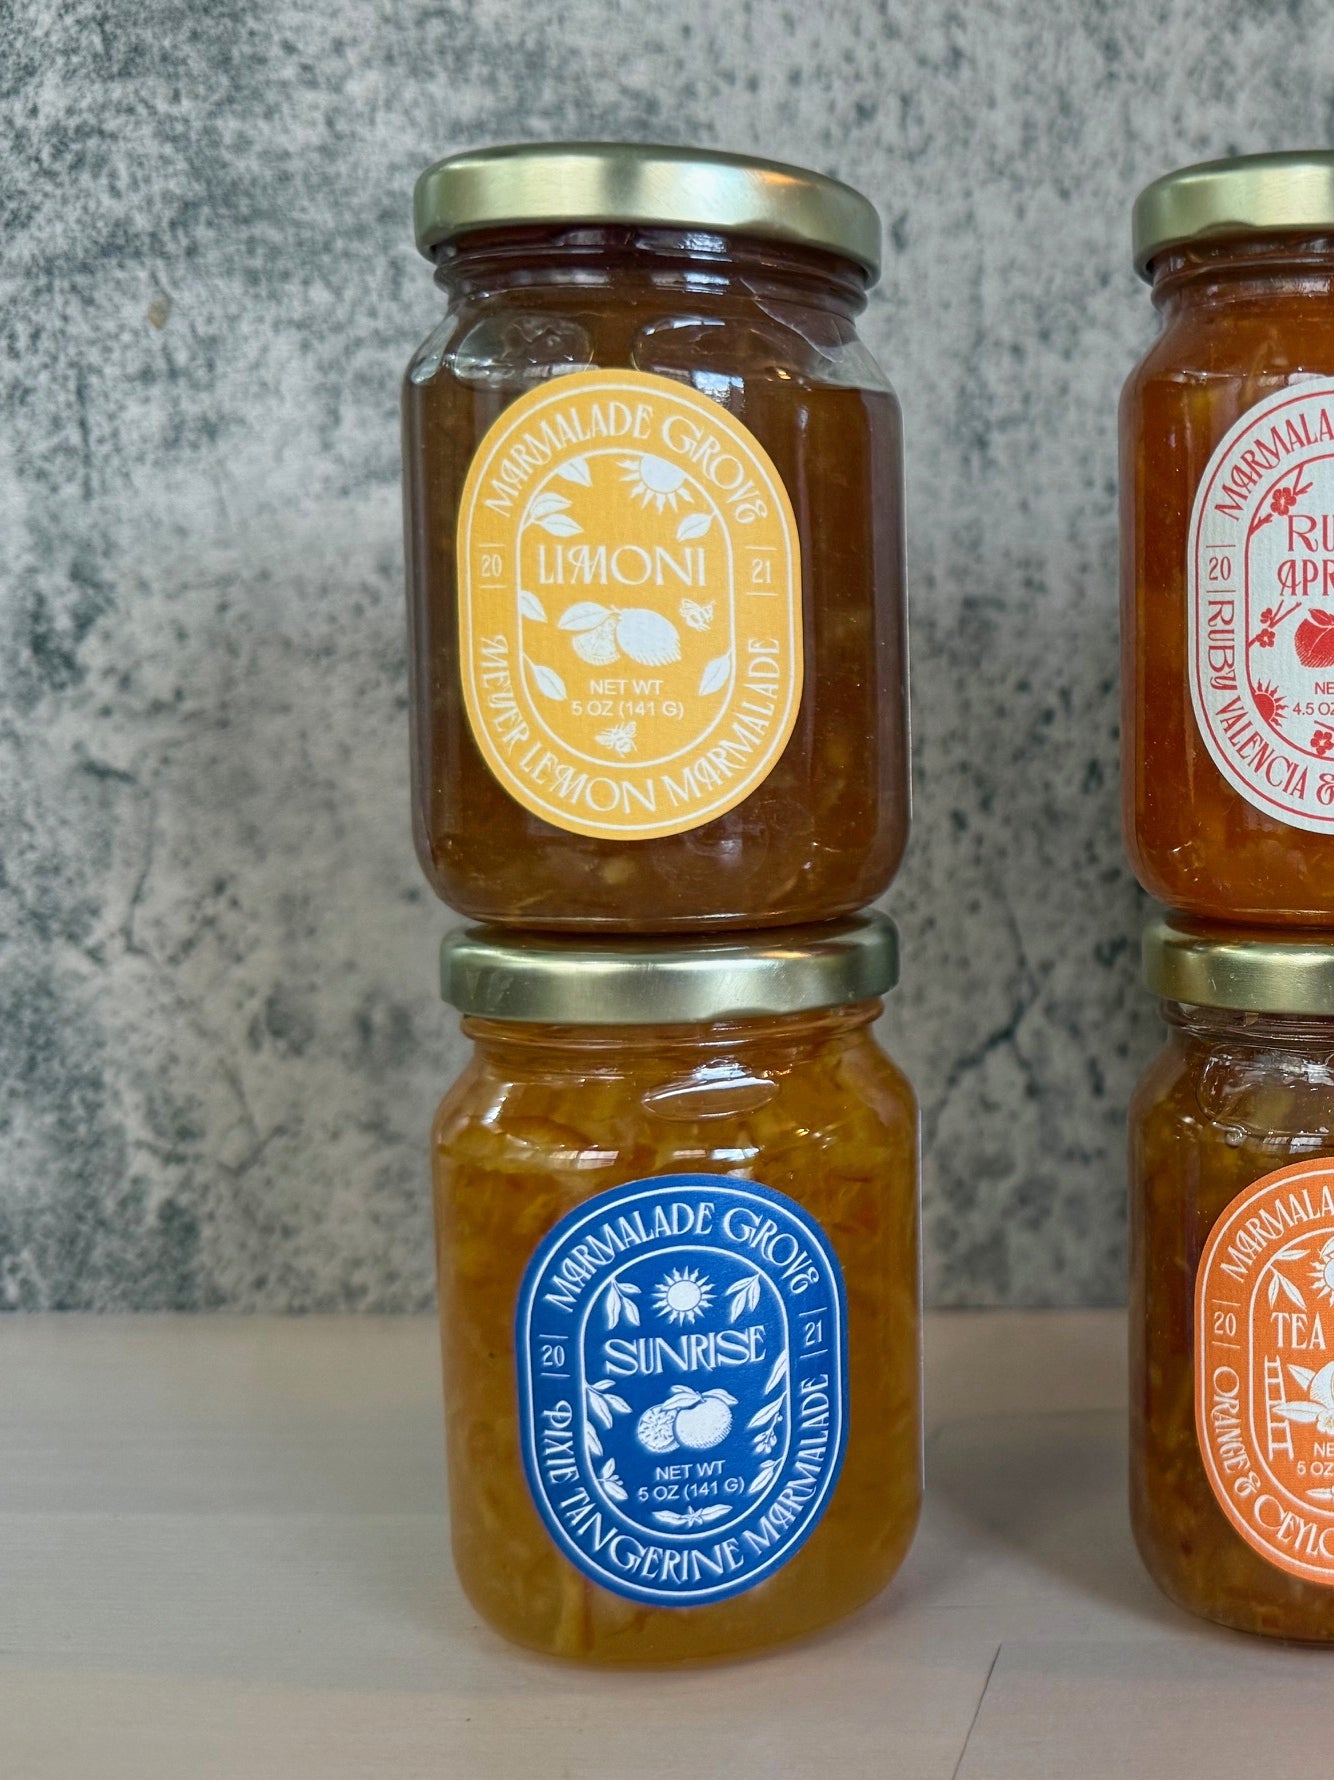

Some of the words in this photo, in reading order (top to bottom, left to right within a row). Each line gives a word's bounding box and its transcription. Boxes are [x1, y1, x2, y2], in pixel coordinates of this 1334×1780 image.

[484, 402, 653, 518] MARMALADE
[662, 415, 769, 524] GROVE
[482, 555, 501, 576] 20
[538, 545, 706, 585] LIMONI
[752, 560, 772, 583] 21
[1209, 557, 1231, 581] 20
[1208, 600, 1237, 690] RUBY
[590, 680, 626, 695] NET
[633, 680, 663, 695] WT
[572, 702, 582, 716] 5
[587, 702, 613, 716] OZ
[619, 702, 656, 718] (141
[662, 702, 684, 719] G)
[1293, 702, 1314, 716] 4.5
[480, 635, 529, 754] MEYER
[520, 741, 657, 814] LEMON
[666, 638, 779, 807] MARMALADE
[1220, 695, 1307, 800] VALENCIA
[545, 1203, 714, 1312] MARMALADE
[723, 1208, 820, 1294] GROVE
[805, 1322, 822, 1343] 21
[1214, 1312, 1236, 1336] 20
[1271, 1312, 1325, 1350] TEA
[543, 1345, 565, 1367] 20
[604, 1325, 767, 1376] SUNRISE
[1211, 1366, 1249, 1475] ORANGE
[1233, 1471, 1261, 1498] &
[542, 1400, 579, 1483] PIXIE
[561, 1487, 744, 1584] TANGERINE
[742, 1373, 830, 1556] MARMALADE
[656, 1465, 692, 1480] NET
[697, 1460, 725, 1476] WT
[1311, 1462, 1334, 1476] OZ
[639, 1487, 649, 1500] 5
[654, 1485, 681, 1499] OZ
[684, 1481, 720, 1499] (141
[725, 1476, 745, 1494] G)
